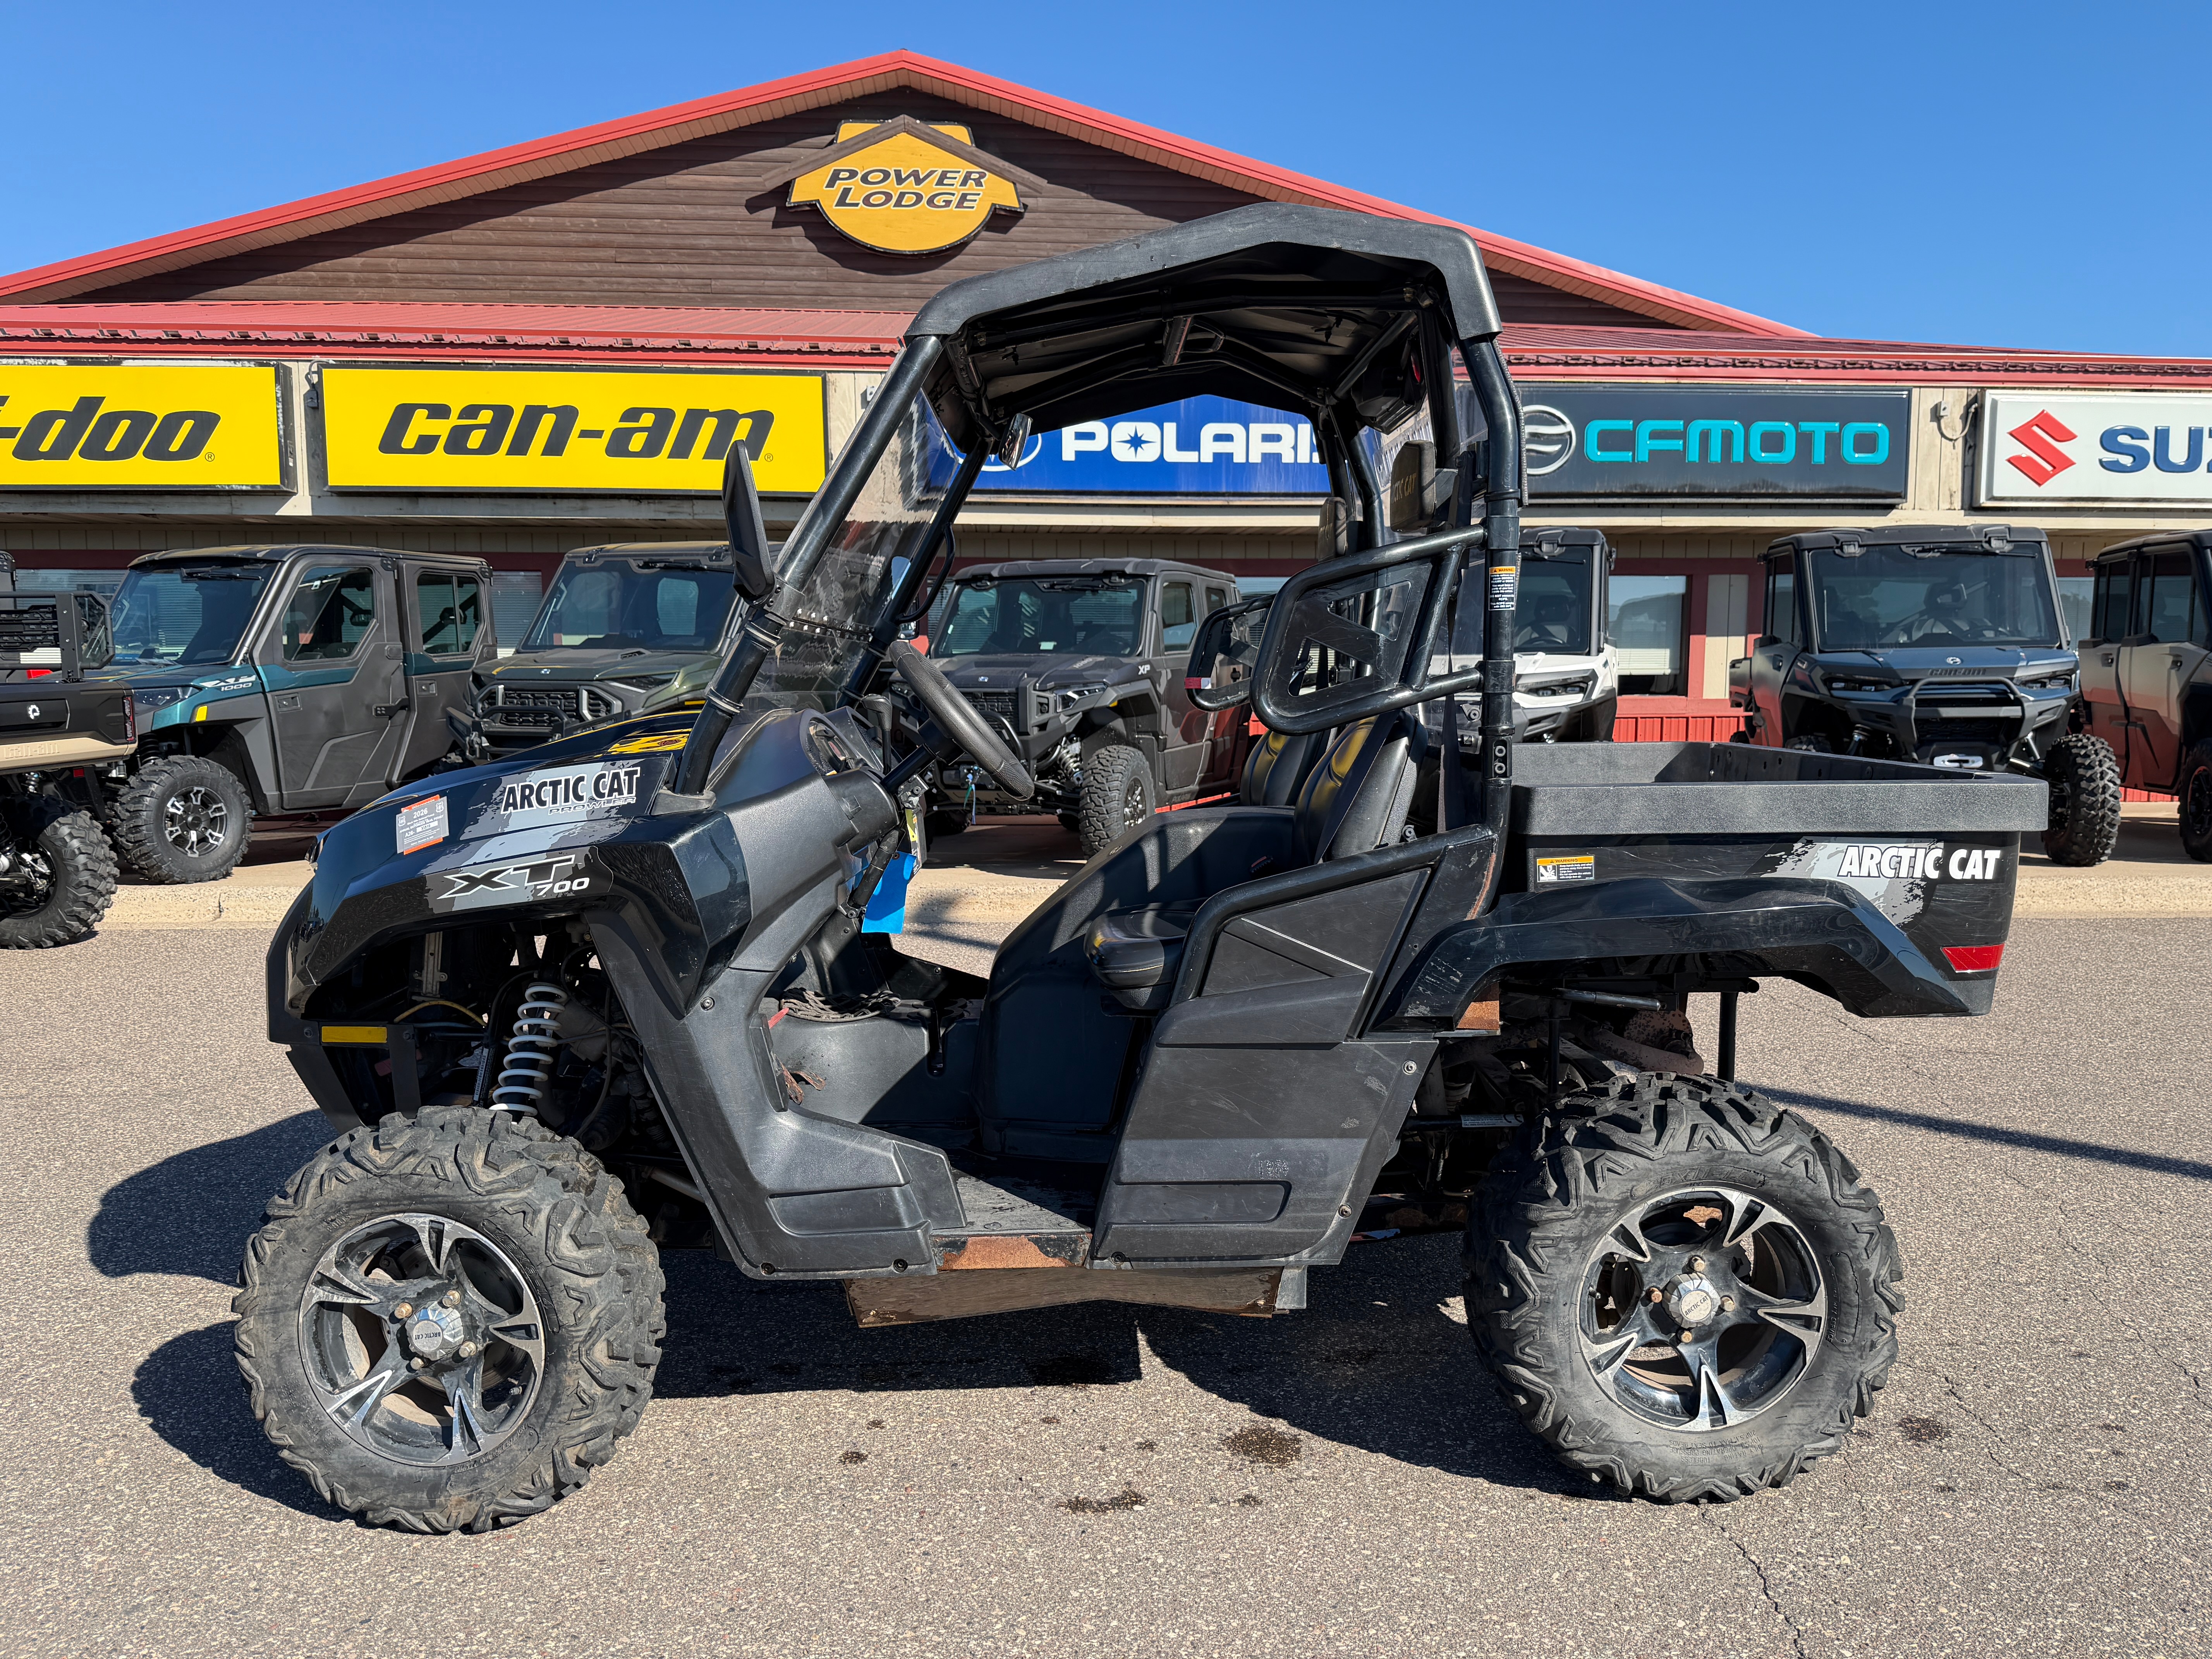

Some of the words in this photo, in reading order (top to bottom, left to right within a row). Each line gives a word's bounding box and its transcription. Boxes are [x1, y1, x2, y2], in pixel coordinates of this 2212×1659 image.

[824, 167, 987, 189] POWER
[834, 187, 981, 210] LODGE
[0, 395, 221, 461] -doo
[379, 403, 775, 461] can-am
[1062, 421, 1319, 463] POLARI
[1584, 419, 1889, 465] CFMOTO
[2098, 425, 2212, 473] SU
[1138, 664, 1151, 675] XP
[221, 682, 252, 691] 1000
[500, 773, 587, 814] ARCTIC
[591, 766, 641, 801] CAT
[413, 808, 428, 819] 2026
[548, 796, 637, 816] PROWLER
[1837, 845, 1943, 878] ARCTIC
[1949, 849, 2001, 879] CAT
[437, 854, 576, 900] XT
[536, 876, 590, 897] 700
[1685, 1302, 1700, 1316] ARCTIC
[1700, 1295, 1708, 1304] CAT
[1669, 1446, 1700, 1455] PRESSURE
[1702, 1446, 1737, 1456] OPERATING
